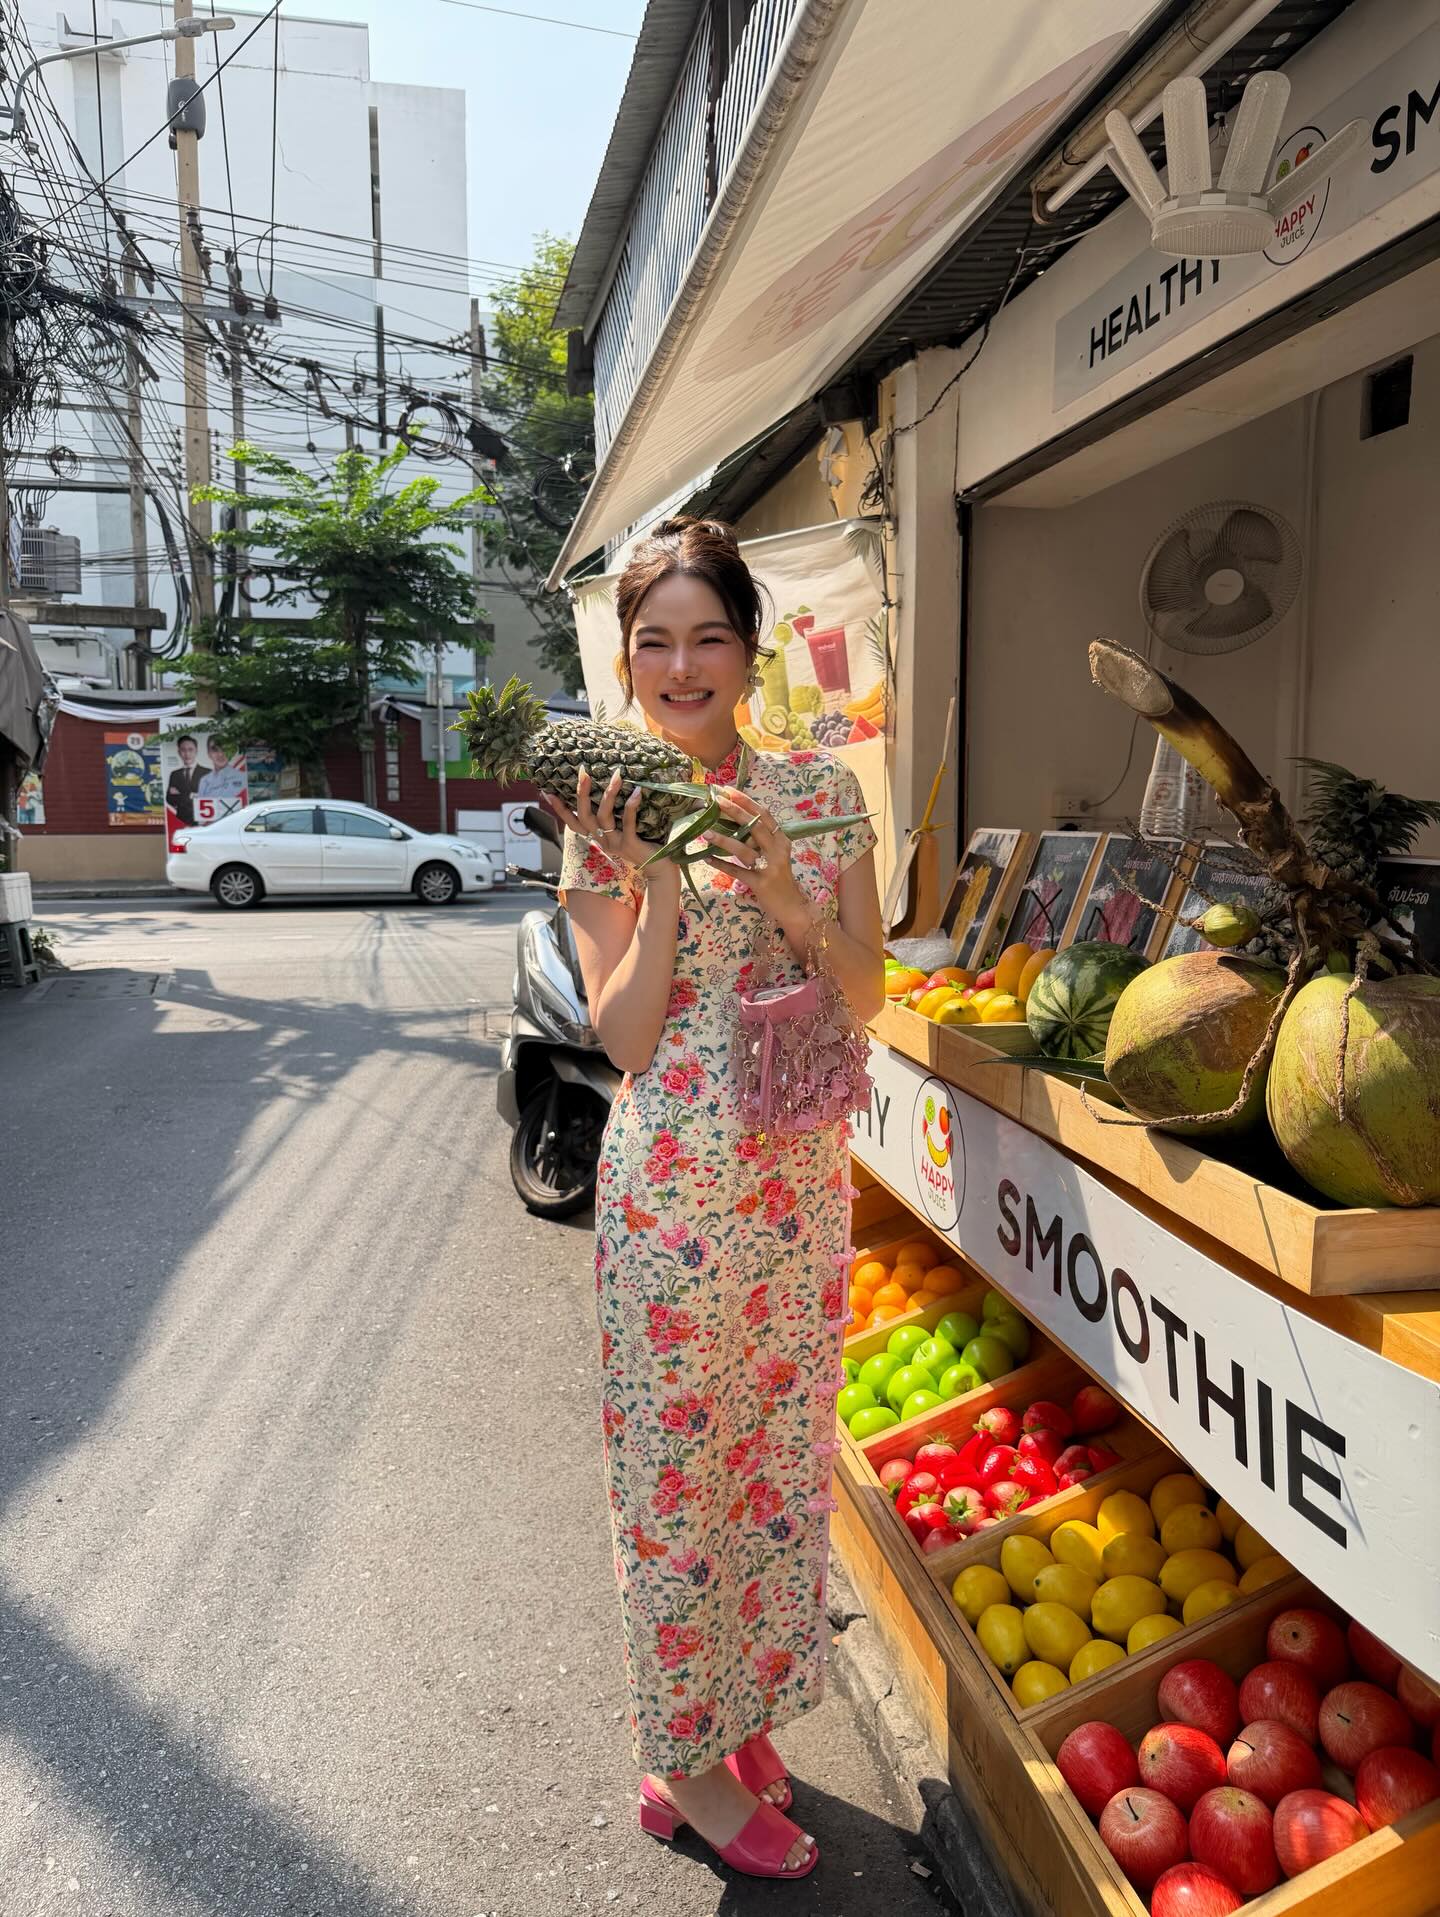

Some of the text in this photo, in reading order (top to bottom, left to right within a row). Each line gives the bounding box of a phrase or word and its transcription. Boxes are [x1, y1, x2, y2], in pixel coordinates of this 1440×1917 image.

[1280, 225, 1306, 249] JUICE
[199, 799, 215, 819] 5
[920, 1155, 955, 1200] HAPPY
[928, 1187, 947, 1211] JUICE
[996, 1178, 1347, 1550] SMOOTHIE
